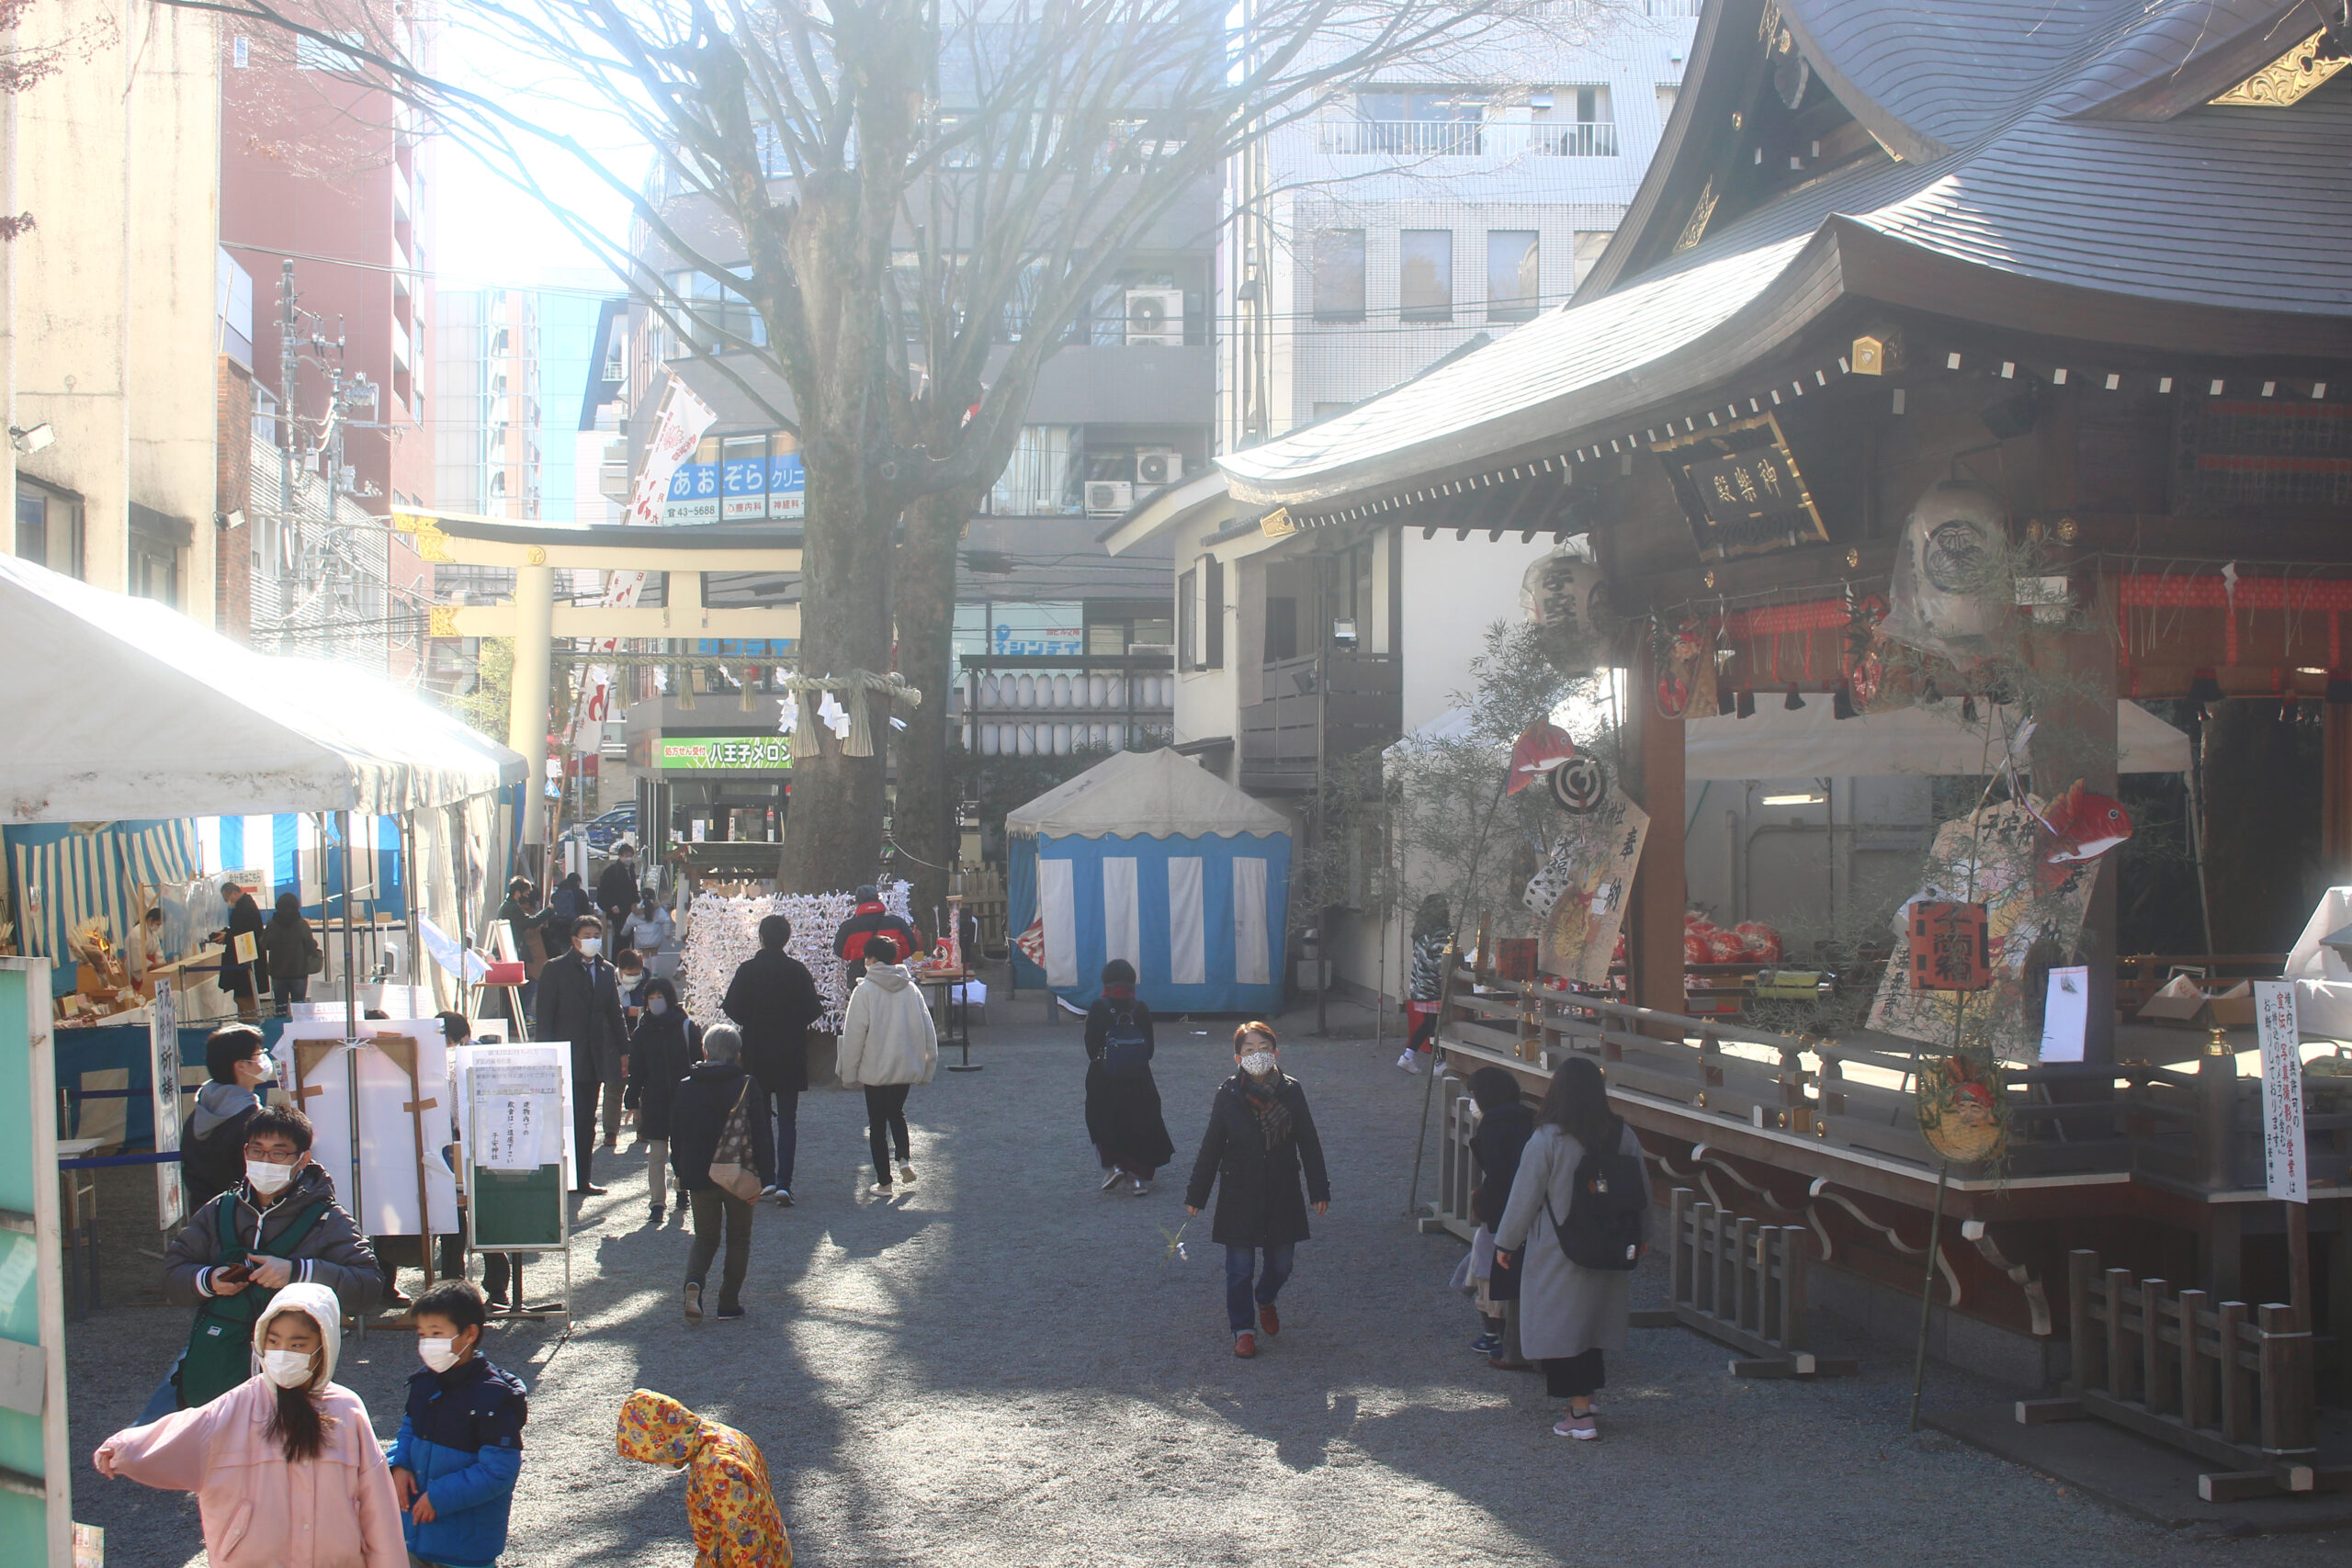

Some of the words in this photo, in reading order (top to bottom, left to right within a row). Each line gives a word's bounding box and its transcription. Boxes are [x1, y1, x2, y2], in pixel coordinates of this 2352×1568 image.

[664, 745, 707, 756] 処方せん受付
[710, 743, 792, 763] 八王子メロン
[2284, 993, 2300, 1128] 境内での無許可の
[2267, 1134, 2275, 1183] 子安神社
